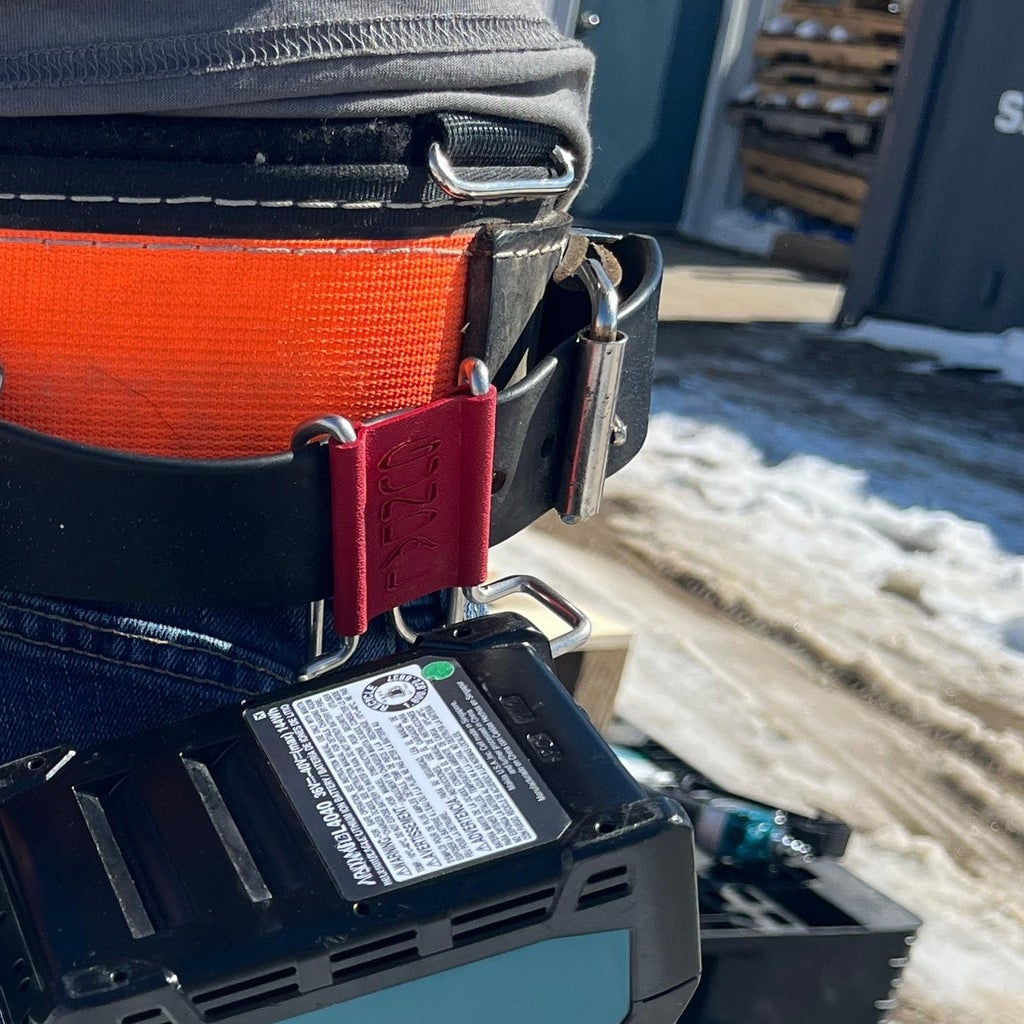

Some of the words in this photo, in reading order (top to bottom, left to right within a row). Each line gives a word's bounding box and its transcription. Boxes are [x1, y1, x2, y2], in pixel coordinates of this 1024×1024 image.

[286, 717, 299, 726] DE
[300, 741, 313, 751] DE
[321, 776, 344, 802] BATTERY
[336, 801, 350, 813] ION
